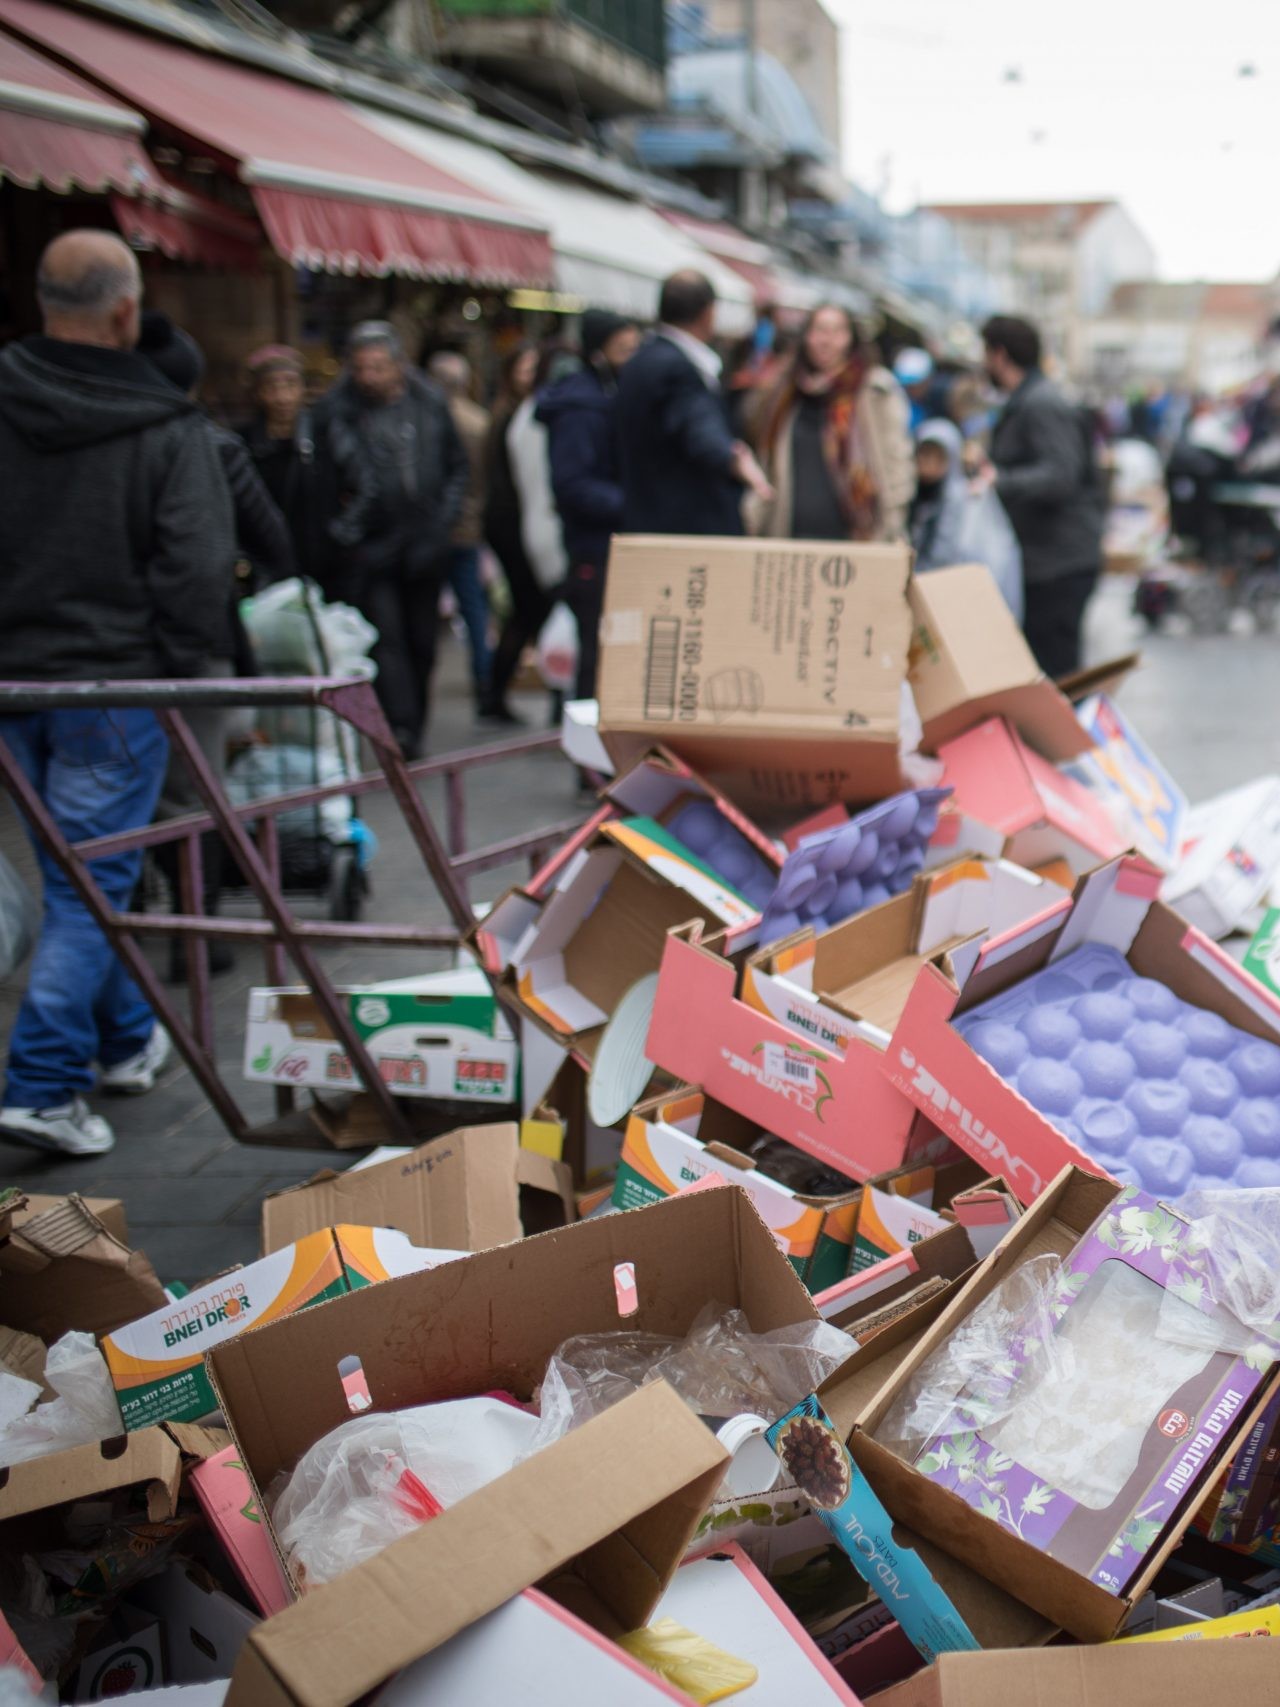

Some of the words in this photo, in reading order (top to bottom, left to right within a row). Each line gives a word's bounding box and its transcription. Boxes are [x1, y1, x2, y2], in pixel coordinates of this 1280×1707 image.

[821, 596, 845, 705] PACTIV
[787, 1010, 818, 1034] BNEI
[210, 1282, 246, 1309] פירות
[160, 1310, 190, 1331] דרור
[191, 1301, 210, 1318] בני
[163, 1318, 203, 1348] BNEI
[159, 1383, 171, 1394] בני
[172, 1373, 194, 1388] פירות
[142, 1390, 159, 1402] דרור
[1162, 1411, 1186, 1435] כרם
[1203, 1388, 1244, 1435] תאנים
[1164, 1431, 1214, 1495] מיובשות
[843, 1513, 910, 1602] MEDJOUL
[872, 1534, 899, 1568] DATES
[1098, 1567, 1113, 1583] 3
